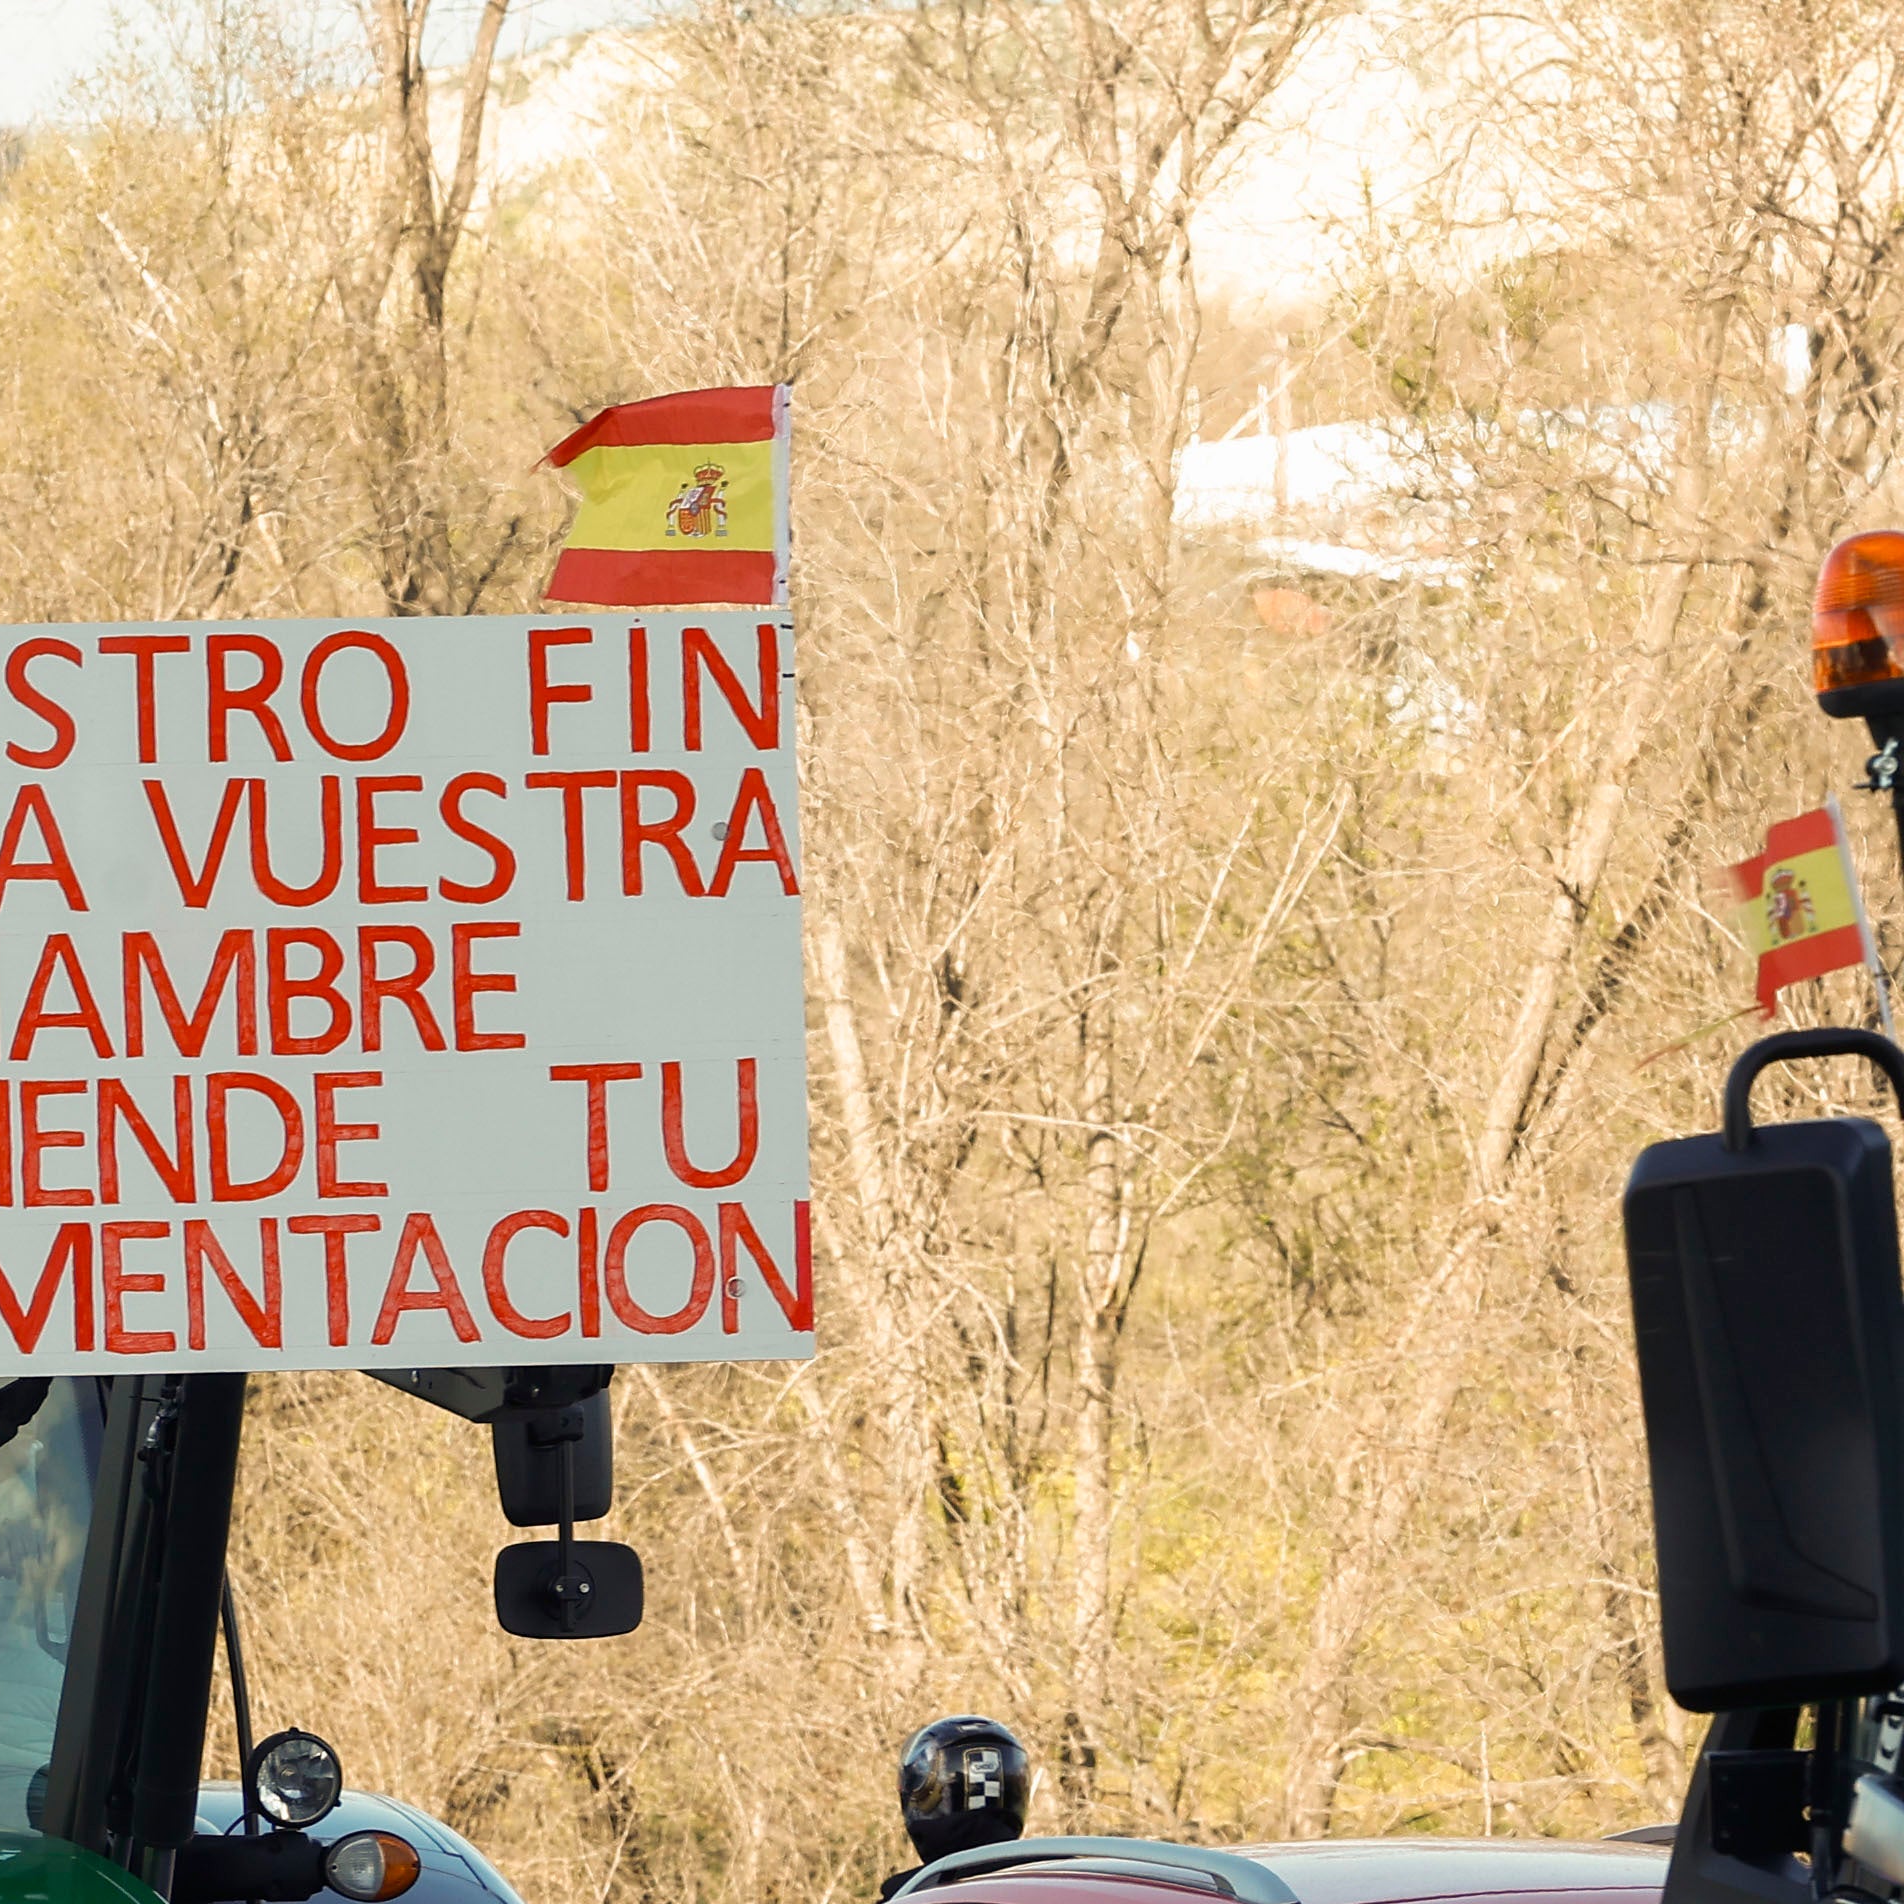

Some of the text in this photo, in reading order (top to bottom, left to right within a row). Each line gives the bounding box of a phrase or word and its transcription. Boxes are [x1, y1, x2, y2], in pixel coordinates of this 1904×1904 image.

[529, 622, 780, 755] FIN
[144, 768, 801, 908] VUESTRA
[551, 1058, 759, 1193] TU
